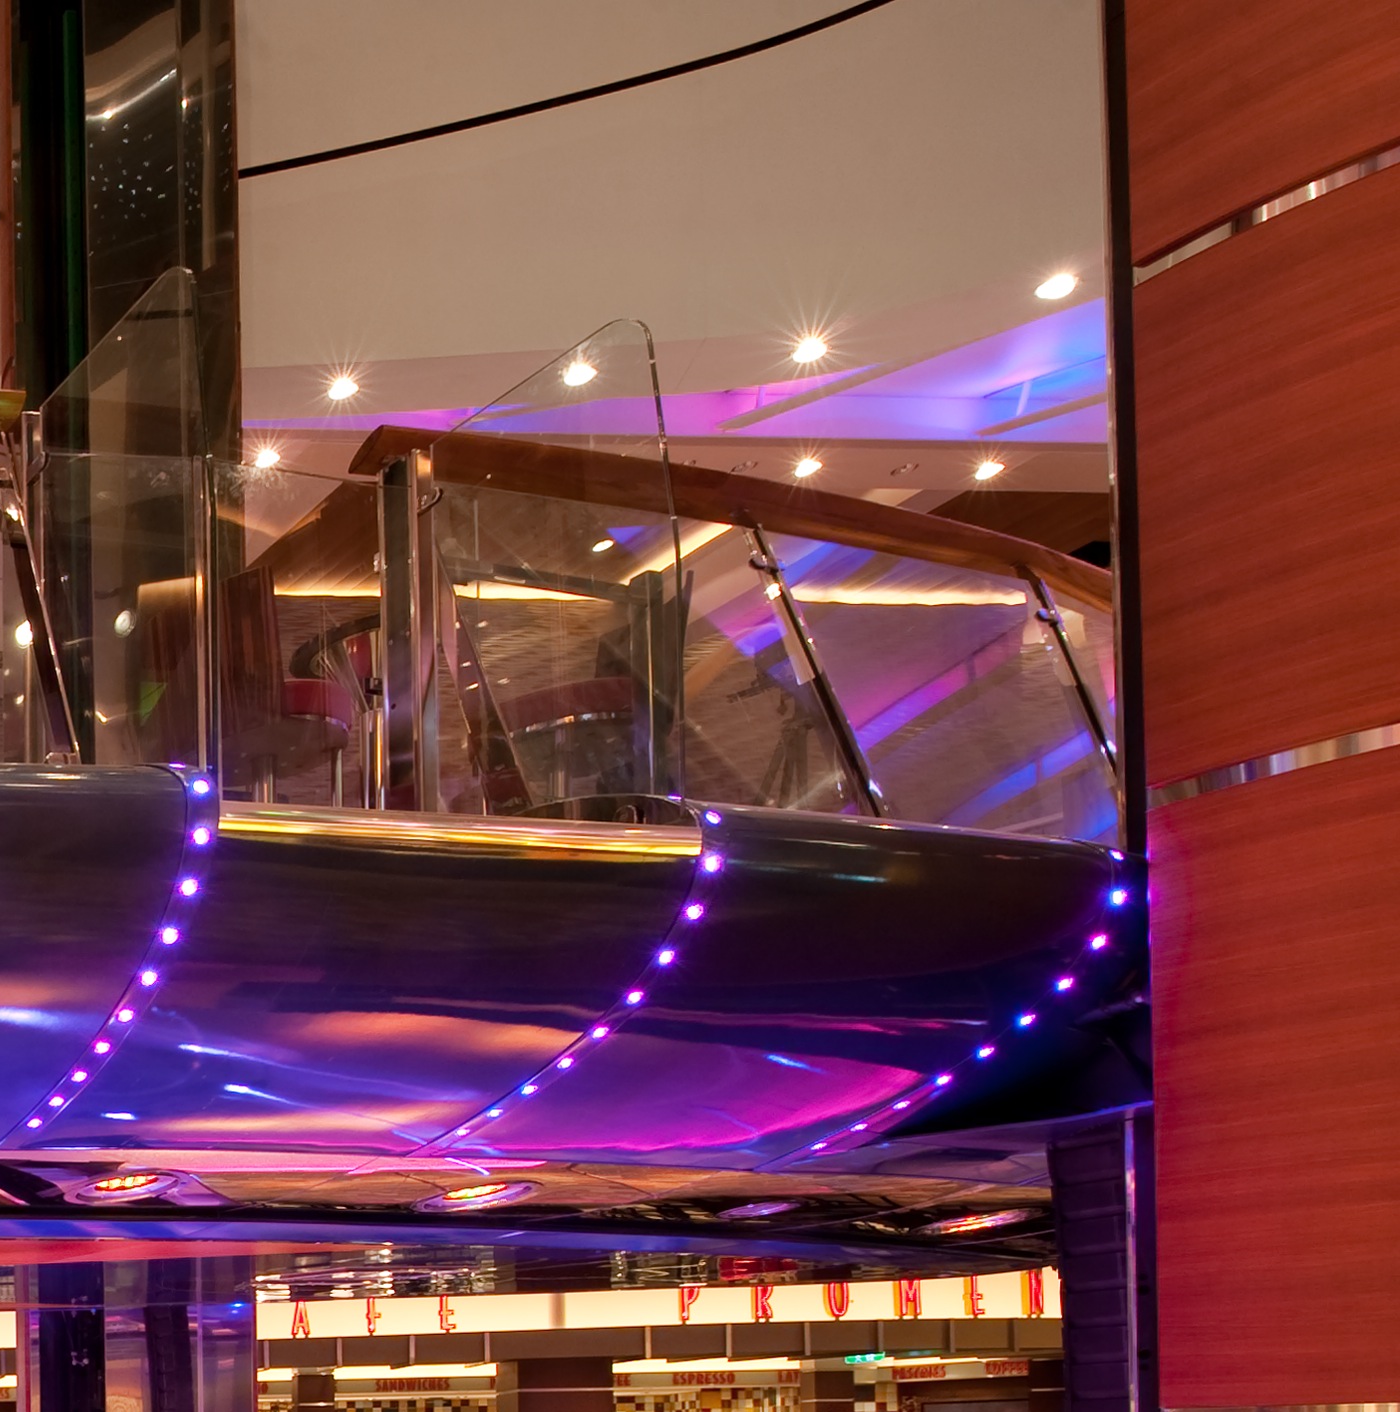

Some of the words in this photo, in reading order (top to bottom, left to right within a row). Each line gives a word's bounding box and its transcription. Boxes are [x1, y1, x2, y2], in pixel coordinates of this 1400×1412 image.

[291, 1294, 458, 1338] AFE
[678, 1268, 1064, 1325] PROMEN
[375, 1377, 450, 1392] SANDWICHES
[672, 1371, 736, 1385] ESPRESSO
